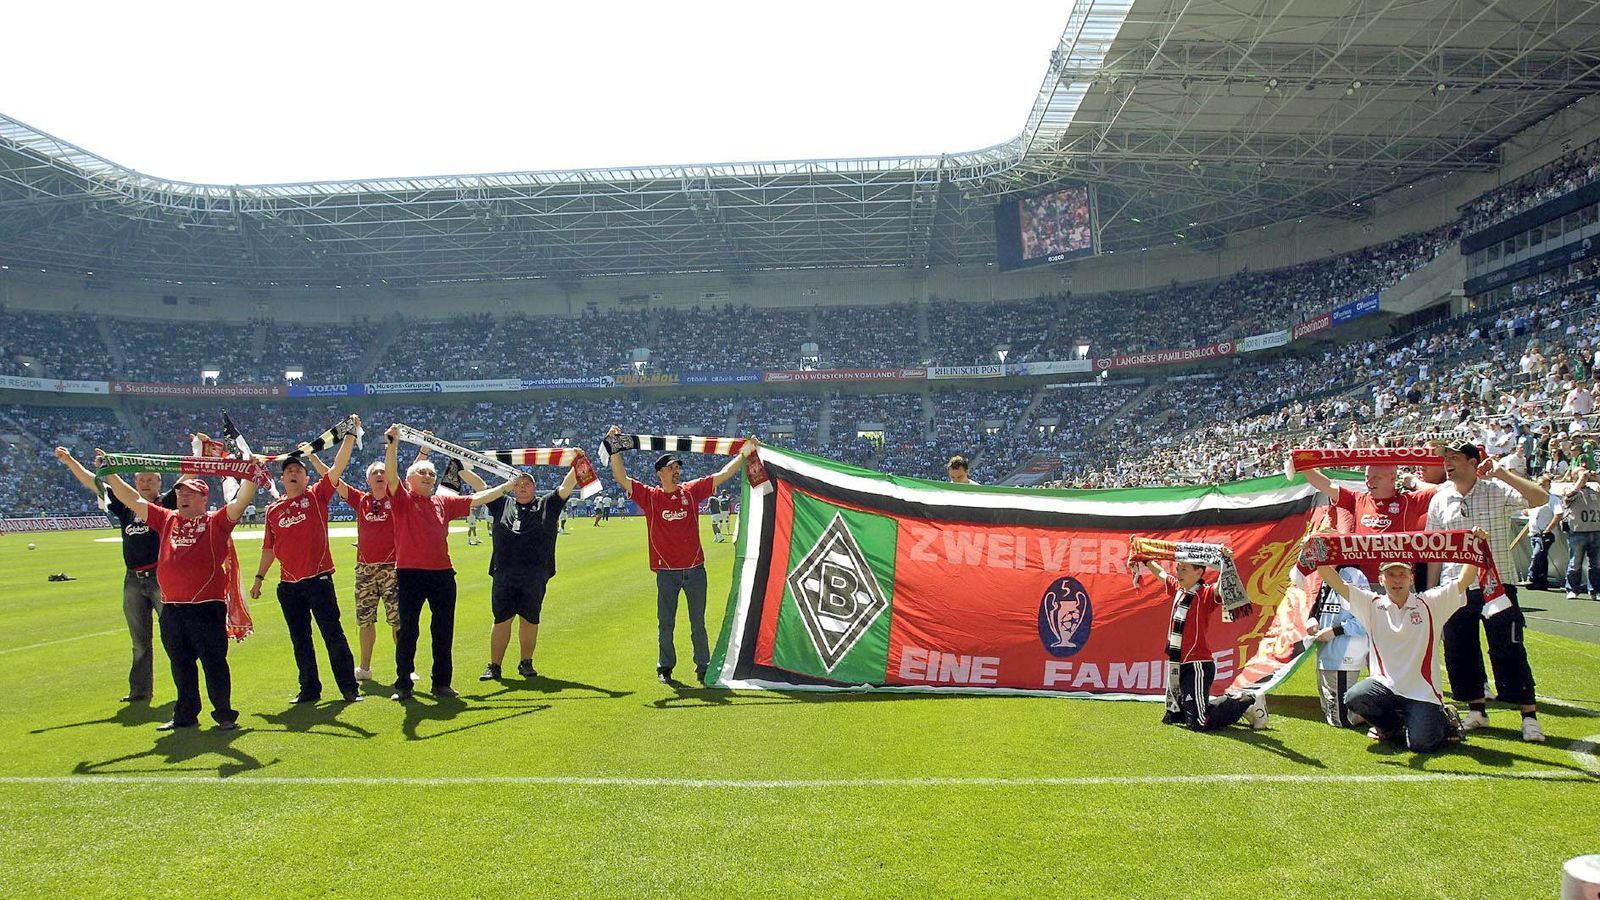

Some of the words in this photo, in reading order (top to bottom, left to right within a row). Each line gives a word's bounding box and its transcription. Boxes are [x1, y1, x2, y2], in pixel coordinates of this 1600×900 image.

[1116, 354, 1156, 366] LANGNESE
[1158, 347, 1215, 362] FAMILIENBLOCK
[935, 367, 979, 375] RHEINISCHE
[9, 379, 41, 388] REGION
[126, 384, 190, 394] Stadtsparkasse
[192, 386, 268, 397] Mönchengladbach
[307, 384, 348, 392] VOLVO
[1320, 447, 1439, 460] LIVERPOOL
[279, 512, 306, 527] Carlsberg
[662, 508, 688, 522] Carlsberg
[0, 519, 56, 532] BAUHAUS
[58, 516, 110, 530] BAUHAUS
[910, 527, 1026, 571] ZWEI
[1339, 533, 1457, 554] LIVERPOOL
[1461, 532, 1483, 554] FC
[1341, 551, 1376, 560] YOU'LL
[1381, 551, 1414, 559] NEVER
[1418, 551, 1447, 559] WALK
[1452, 550, 1484, 563] ALONE
[818, 562, 859, 619] B
[1061, 580, 1070, 597] 5
[899, 645, 1001, 684] EINE
[1043, 648, 1234, 690] FAMIE
